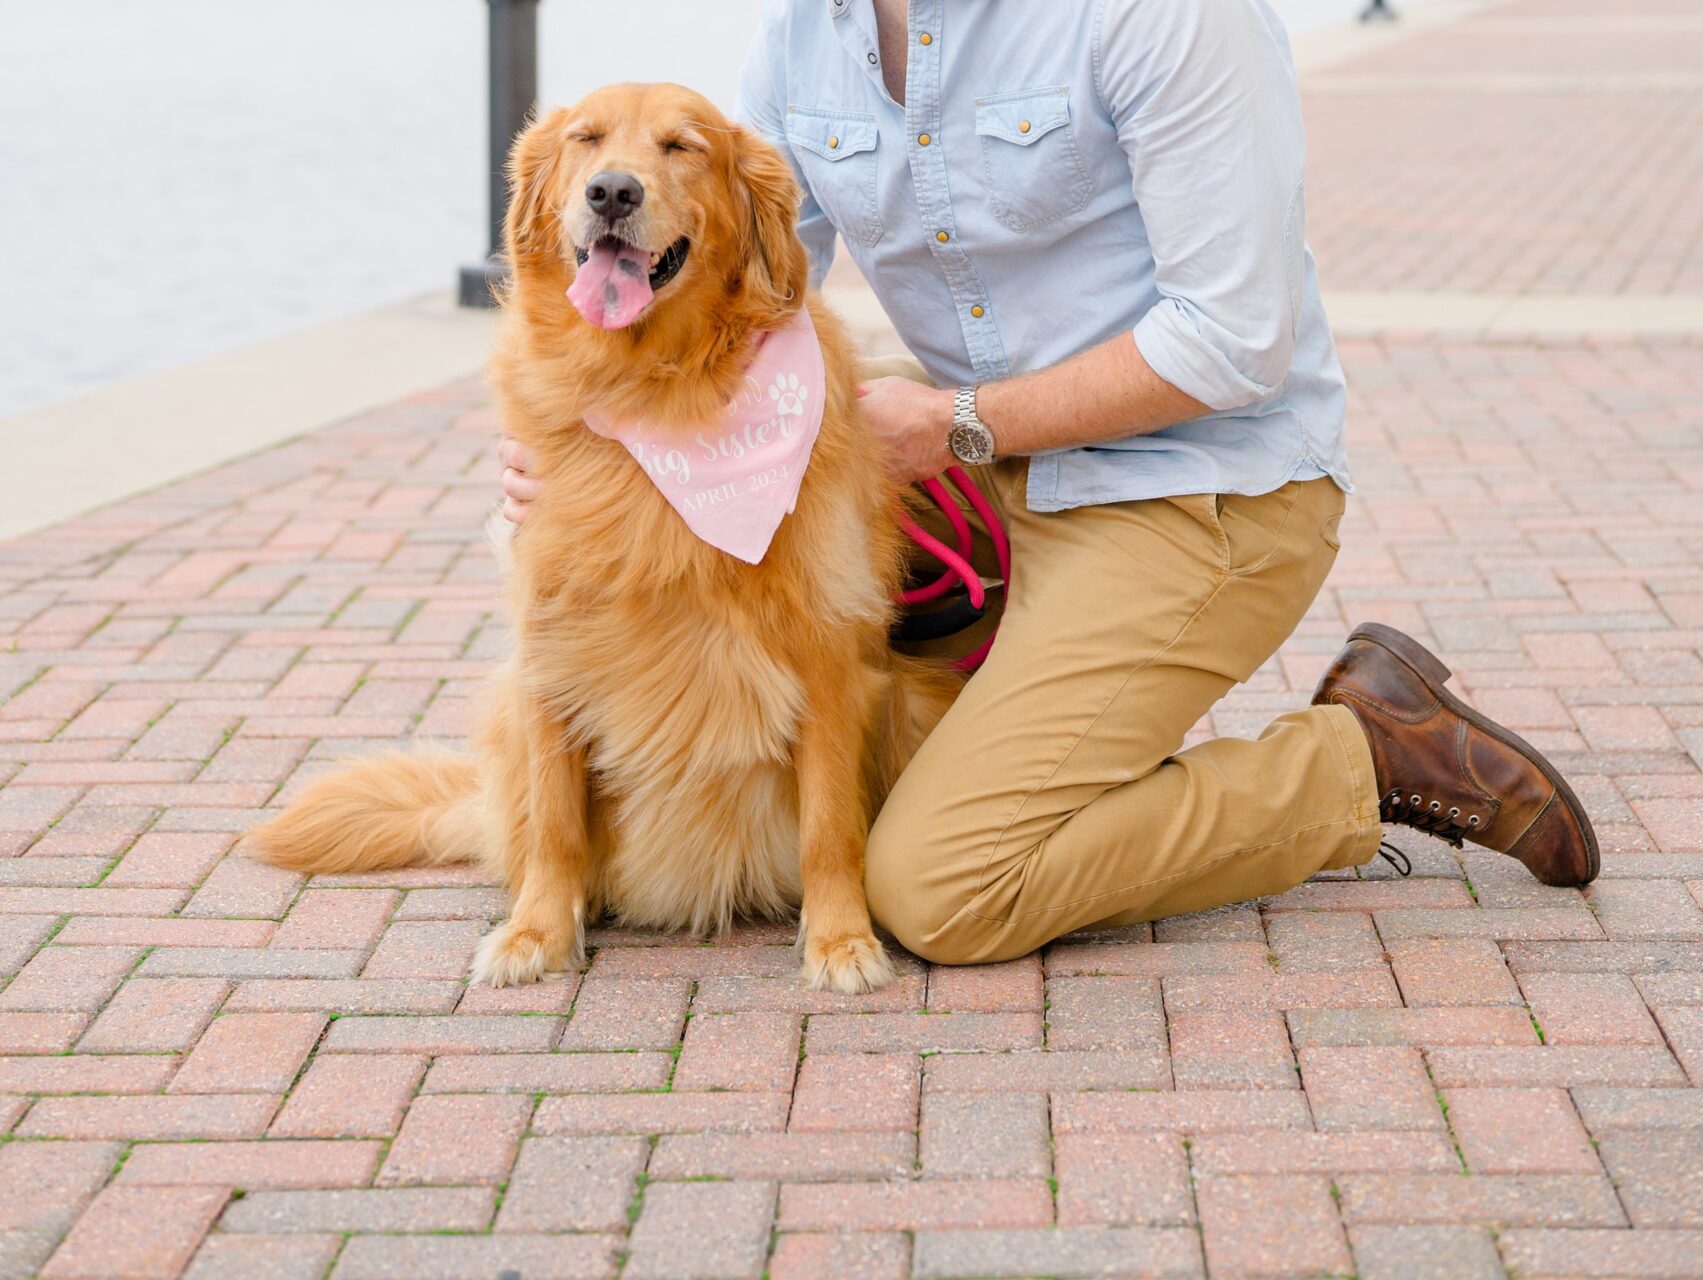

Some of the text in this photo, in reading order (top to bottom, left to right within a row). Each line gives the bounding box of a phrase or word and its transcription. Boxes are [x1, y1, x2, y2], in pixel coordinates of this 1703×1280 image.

[632, 416, 793, 484] Big Sister
[681, 465, 790, 514] APRIL 2024
